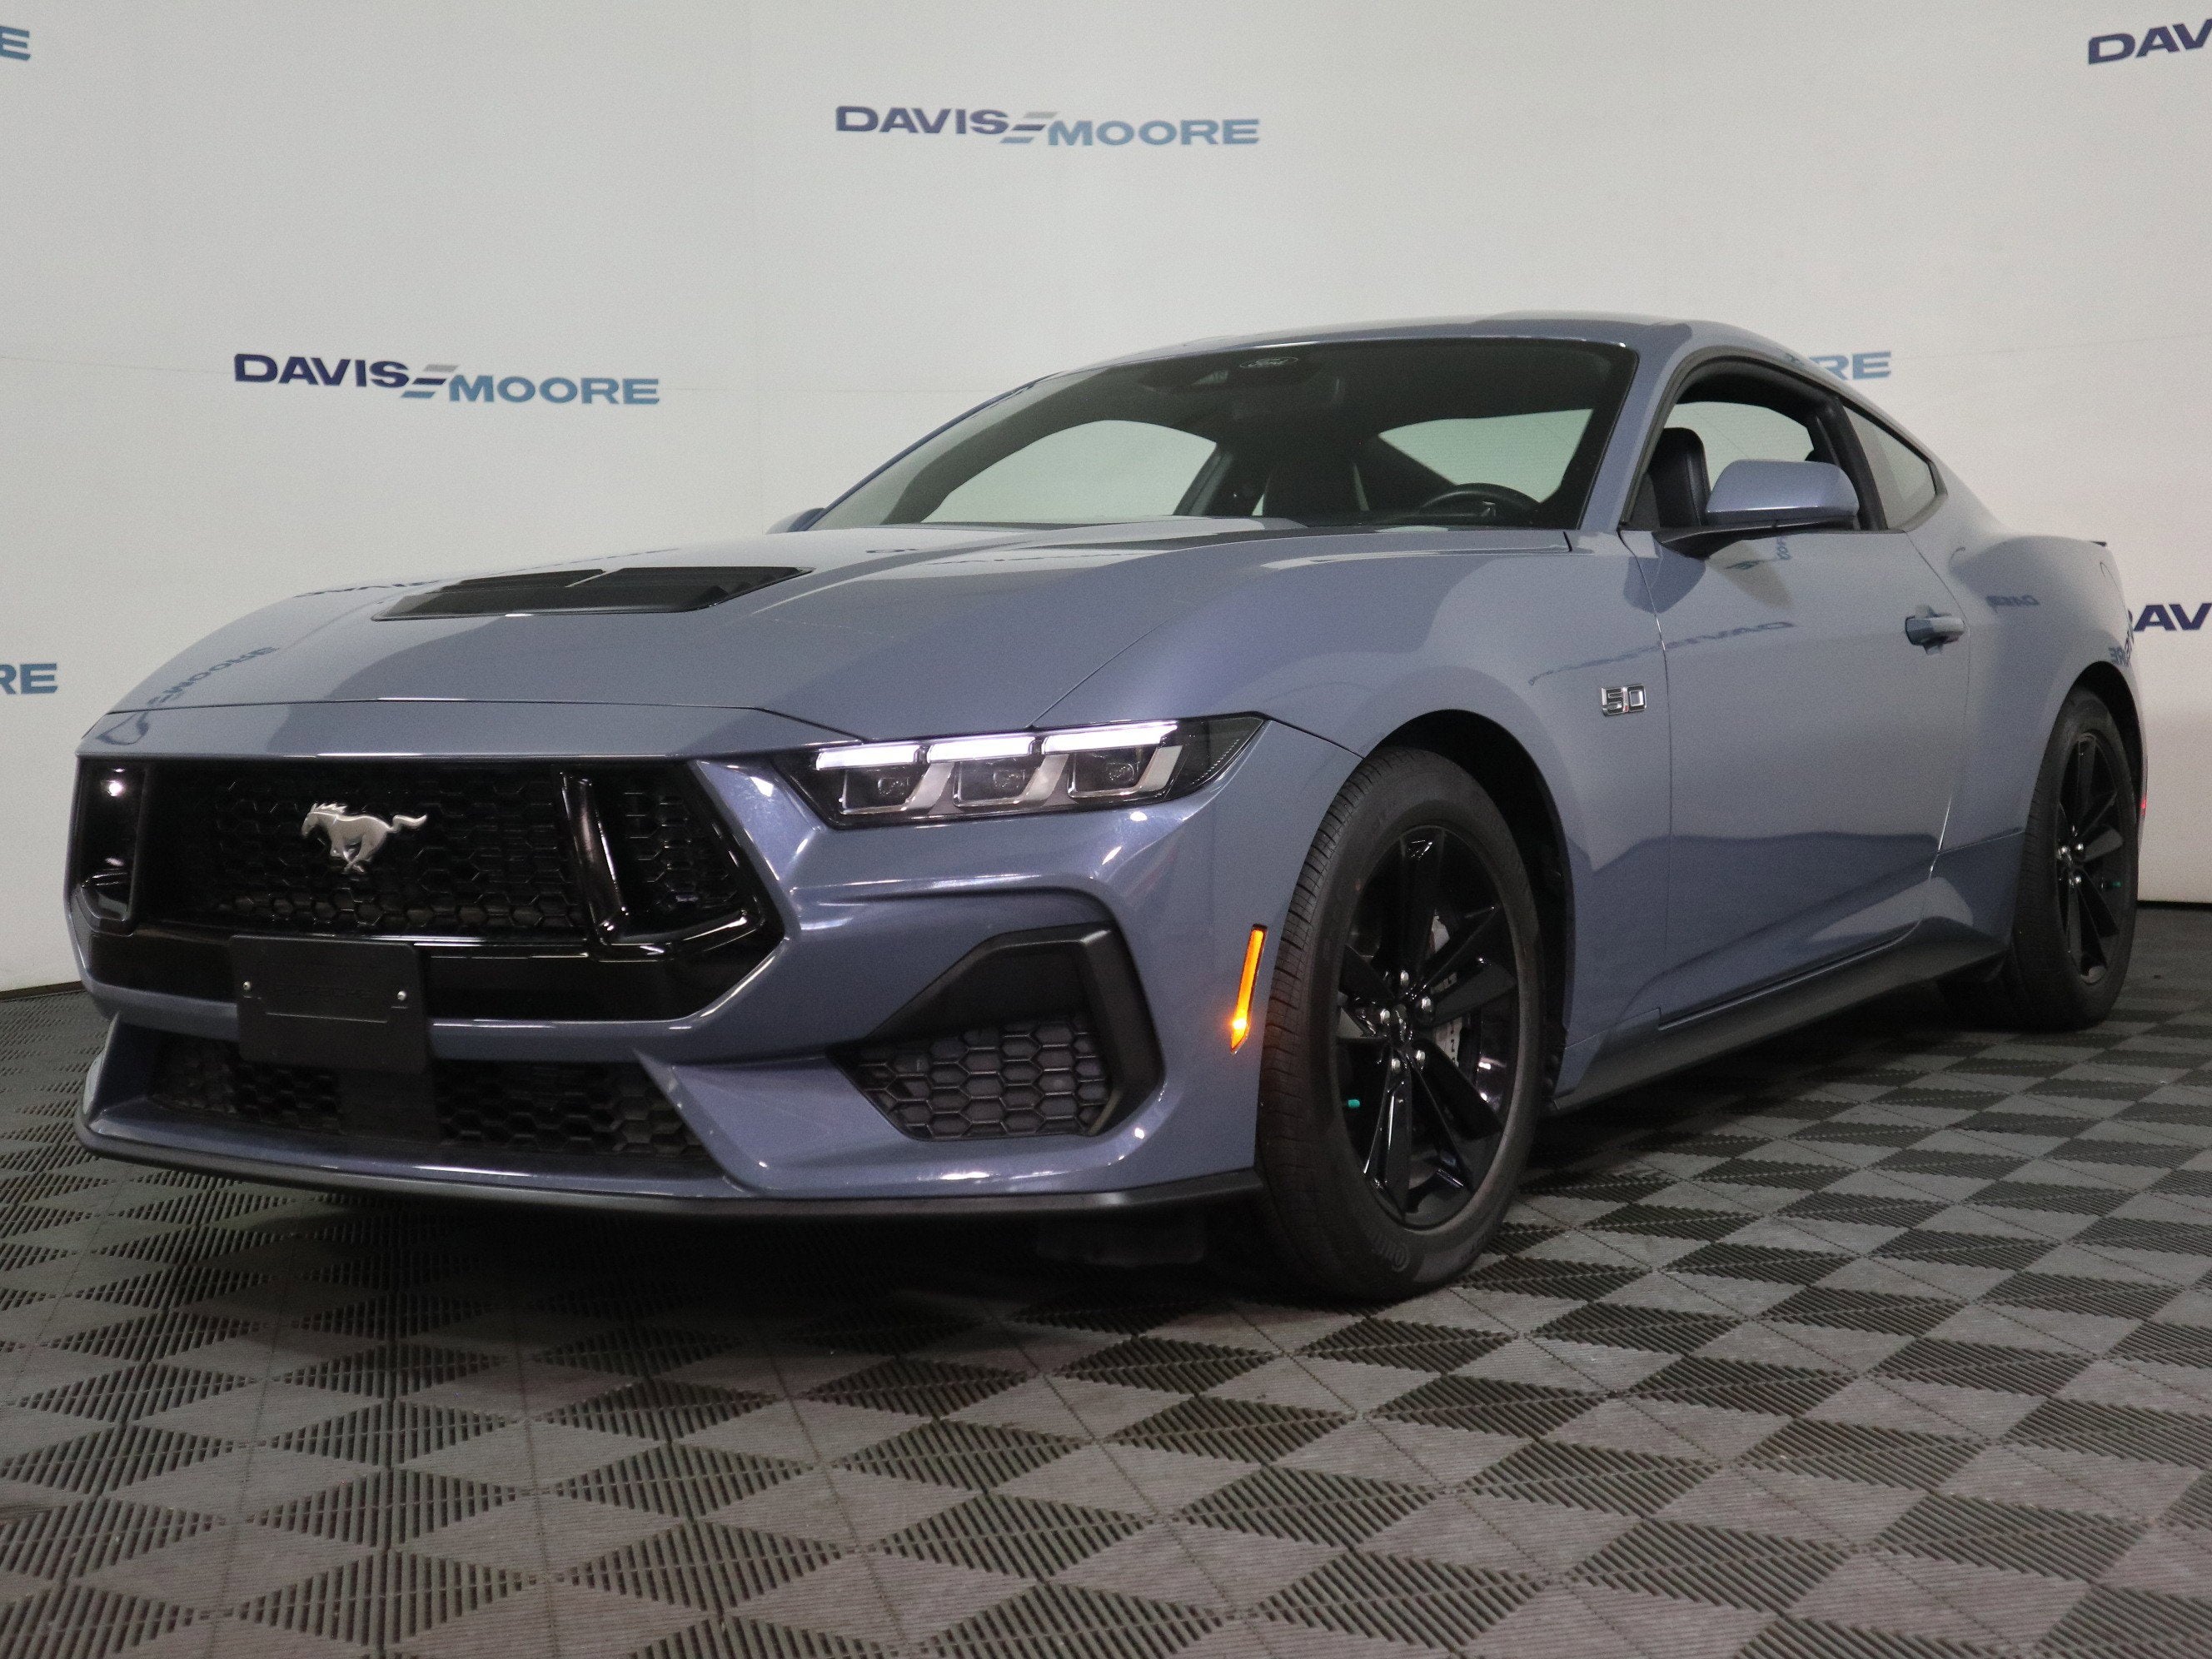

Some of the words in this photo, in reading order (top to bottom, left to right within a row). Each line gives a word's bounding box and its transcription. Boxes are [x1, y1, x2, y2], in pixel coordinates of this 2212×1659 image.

[834, 105, 1010, 136] DAVIS
[1048, 118, 1259, 147] MOORE
[232, 352, 411, 390] DAVIS
[448, 374, 660, 406] MOORE
